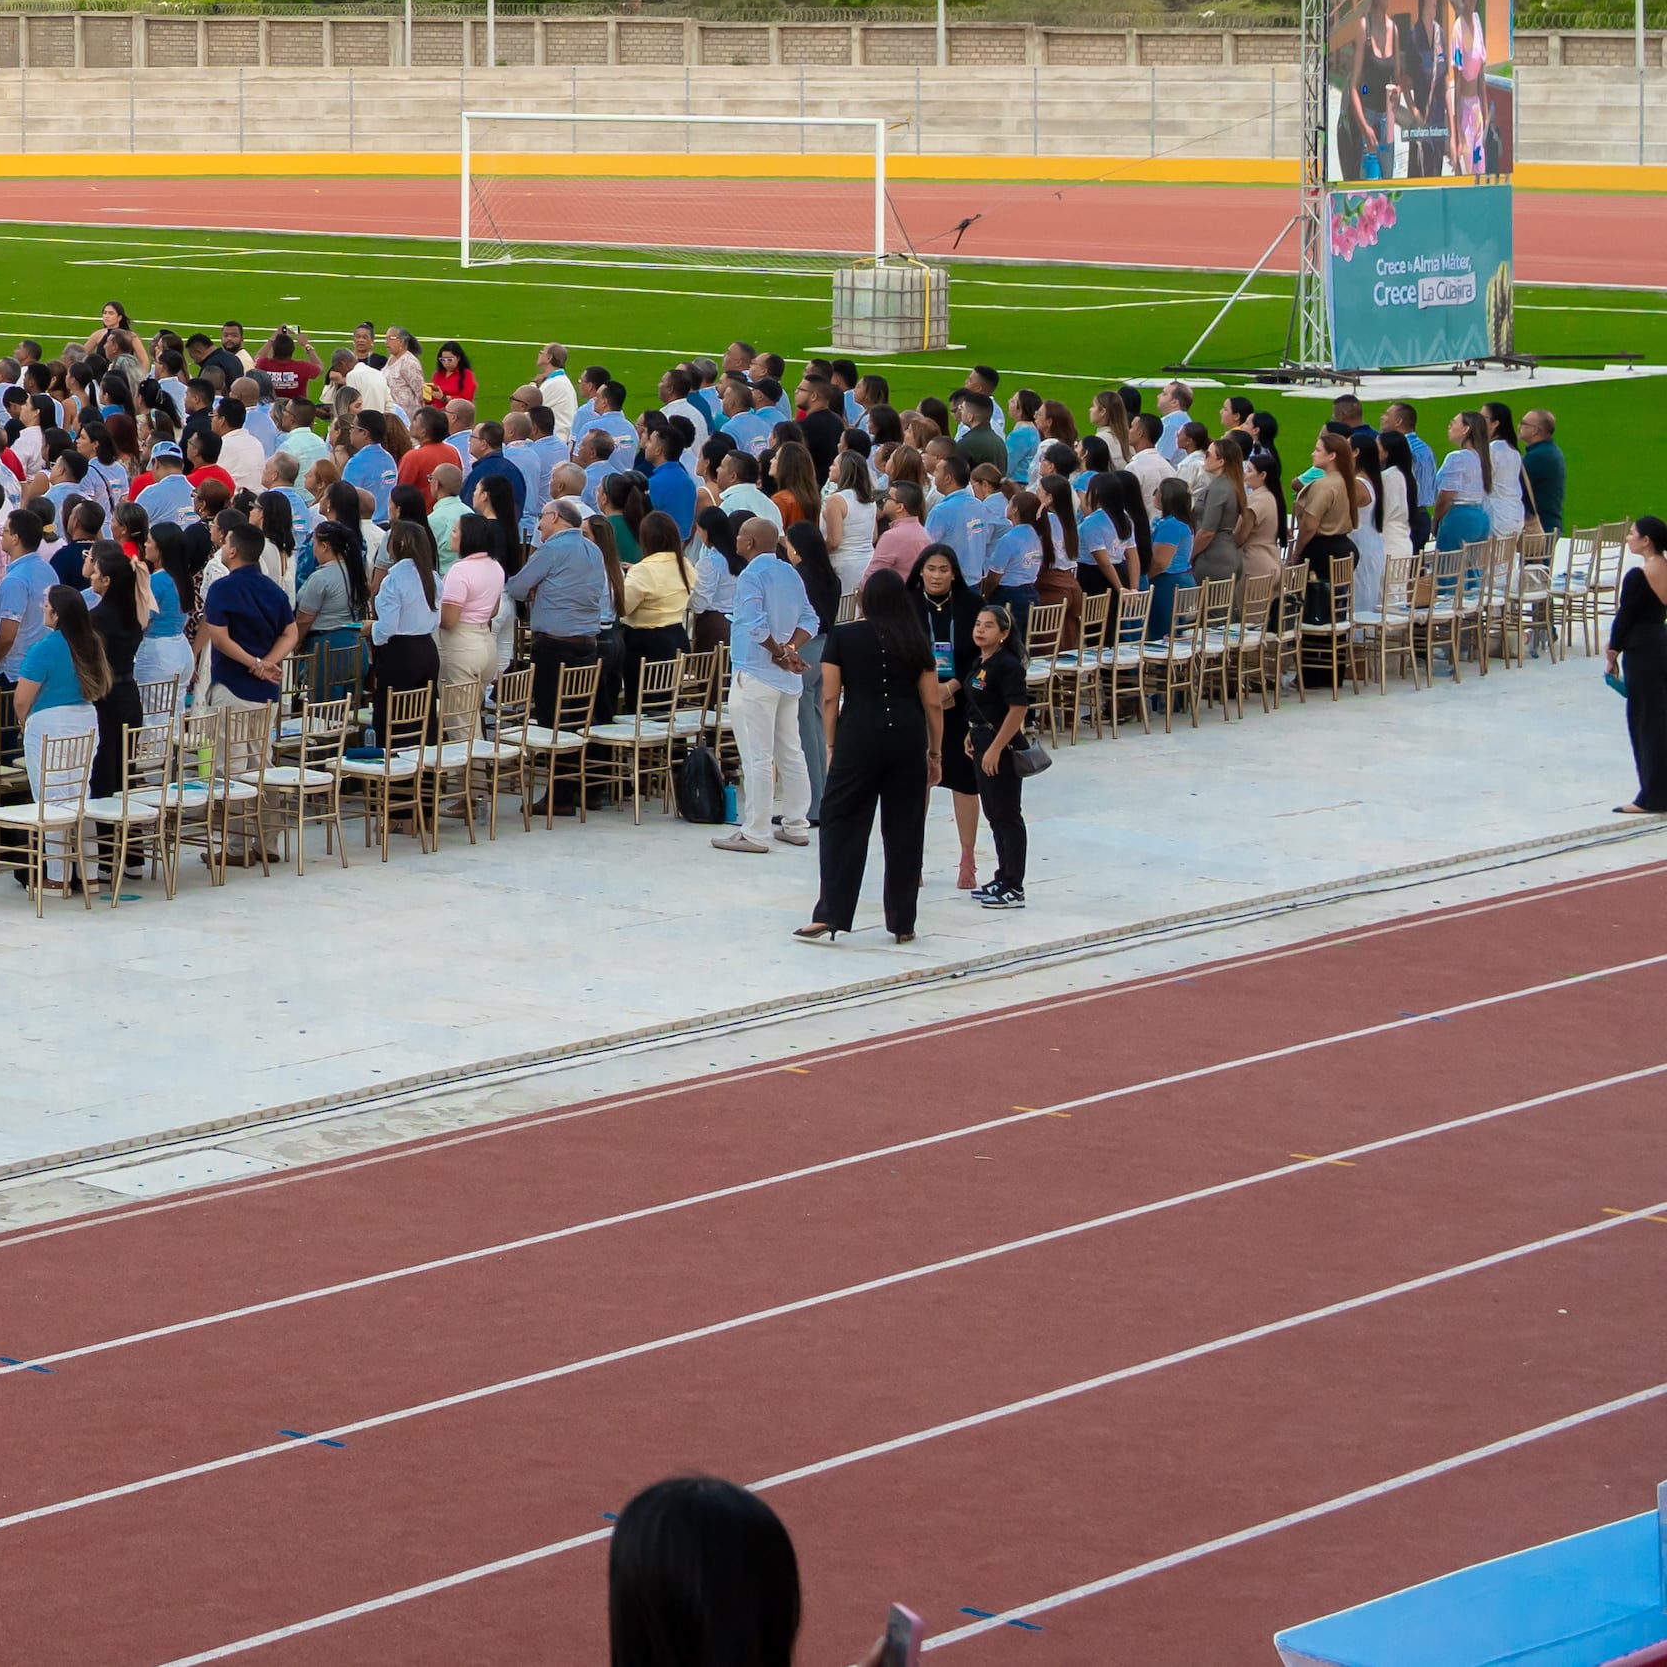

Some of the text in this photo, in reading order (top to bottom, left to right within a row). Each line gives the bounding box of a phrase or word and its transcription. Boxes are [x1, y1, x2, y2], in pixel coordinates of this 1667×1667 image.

[1376, 258, 1406, 276] Crece
[1413, 255, 1440, 273] Alma
[1441, 253, 1472, 272] Máter,
[1373, 280, 1473, 306] Crece La Guajira
